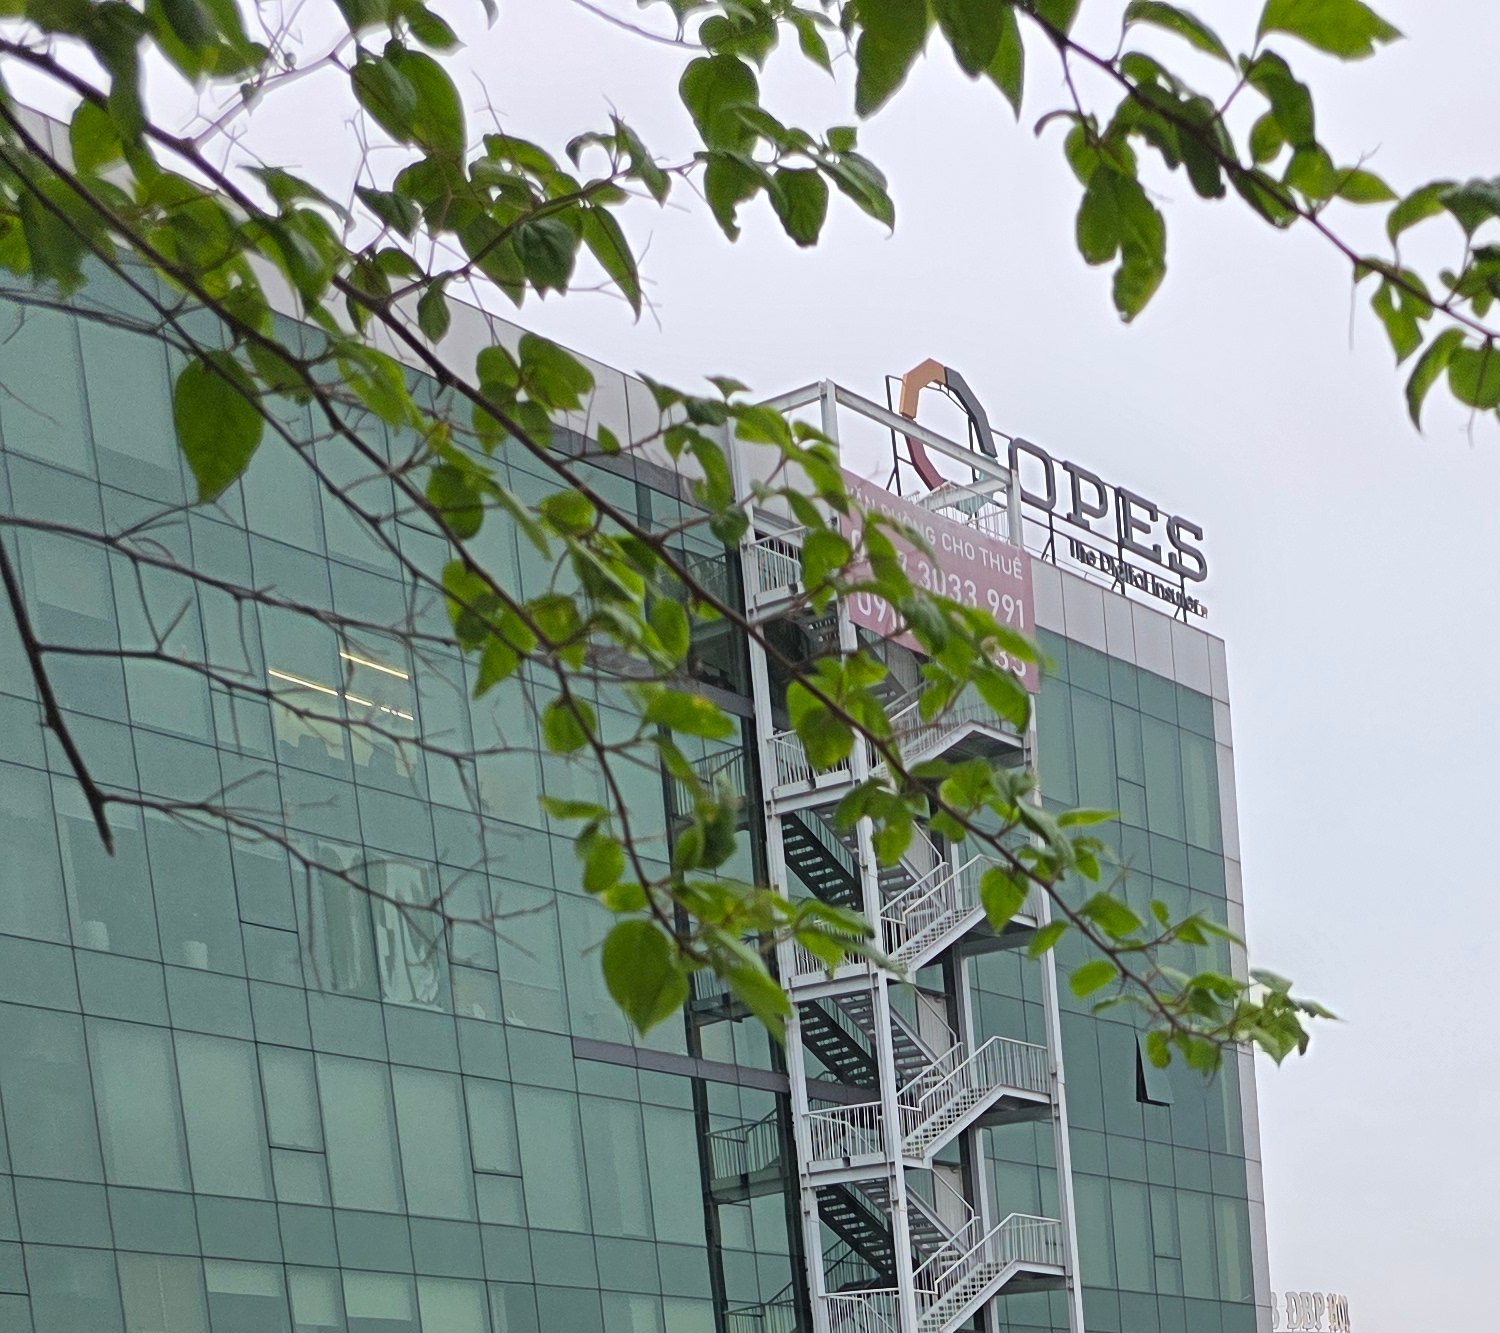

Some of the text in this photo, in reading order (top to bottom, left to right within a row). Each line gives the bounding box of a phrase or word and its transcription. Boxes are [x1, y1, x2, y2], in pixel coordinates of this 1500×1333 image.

[1008, 437, 1208, 583] OPES
[941, 532, 976, 561] CHO
[979, 548, 1024, 581] THUÊ
[986, 588, 1025, 630] 991
[1285, 1291, 1325, 1330] ĐBP
